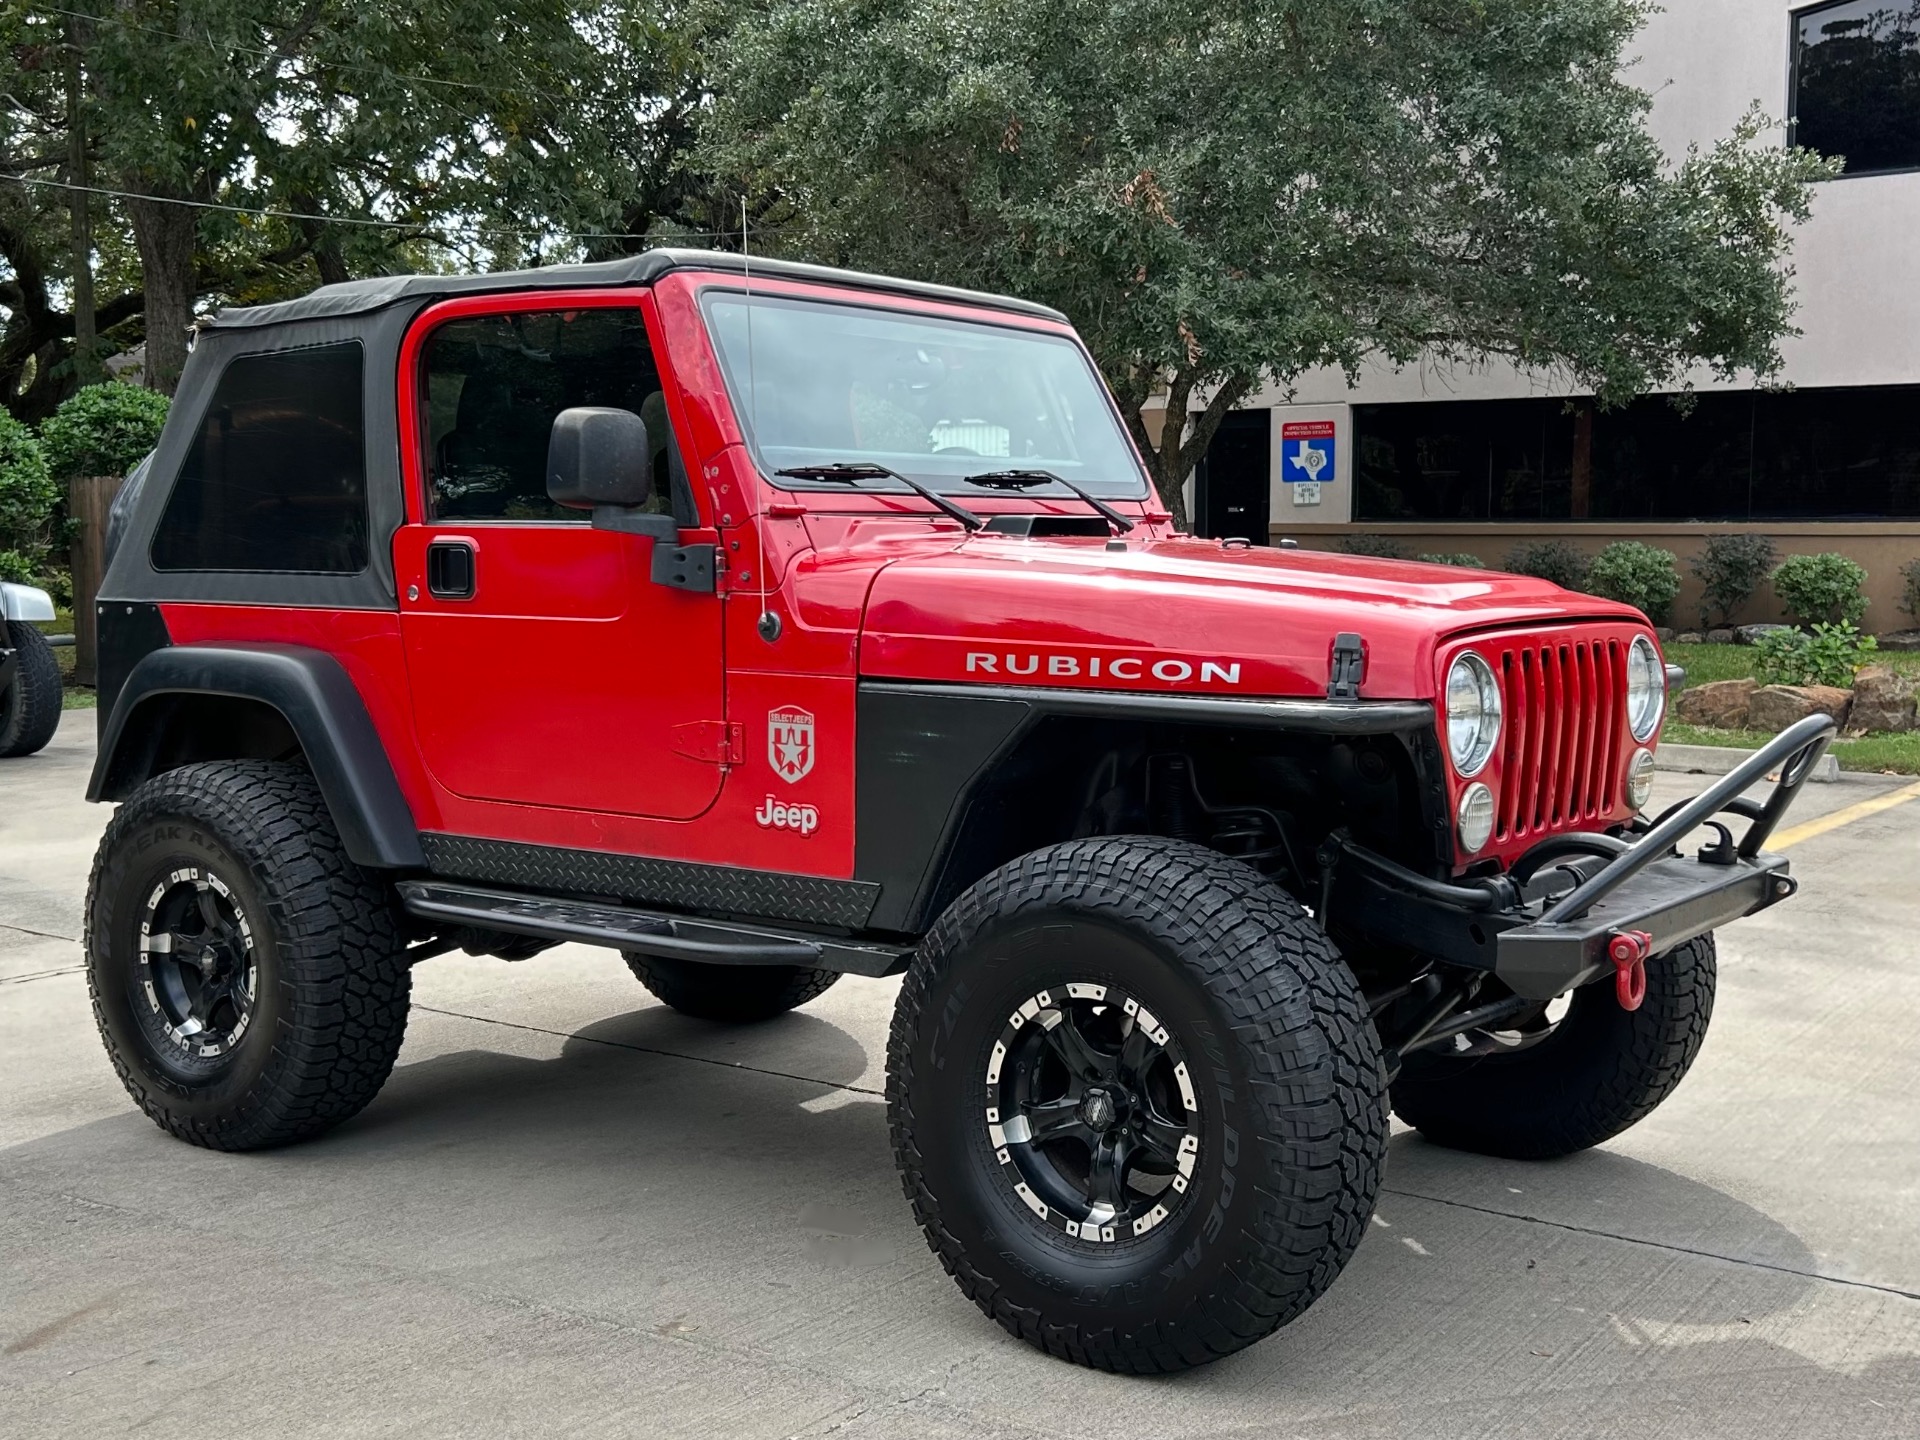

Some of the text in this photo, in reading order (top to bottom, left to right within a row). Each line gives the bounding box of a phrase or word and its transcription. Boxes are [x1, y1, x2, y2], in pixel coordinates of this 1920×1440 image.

[966, 652, 1241, 684] RUBICON
[770, 713, 812, 725] SELECT JEEPS
[755, 796, 819, 834] Jeep
